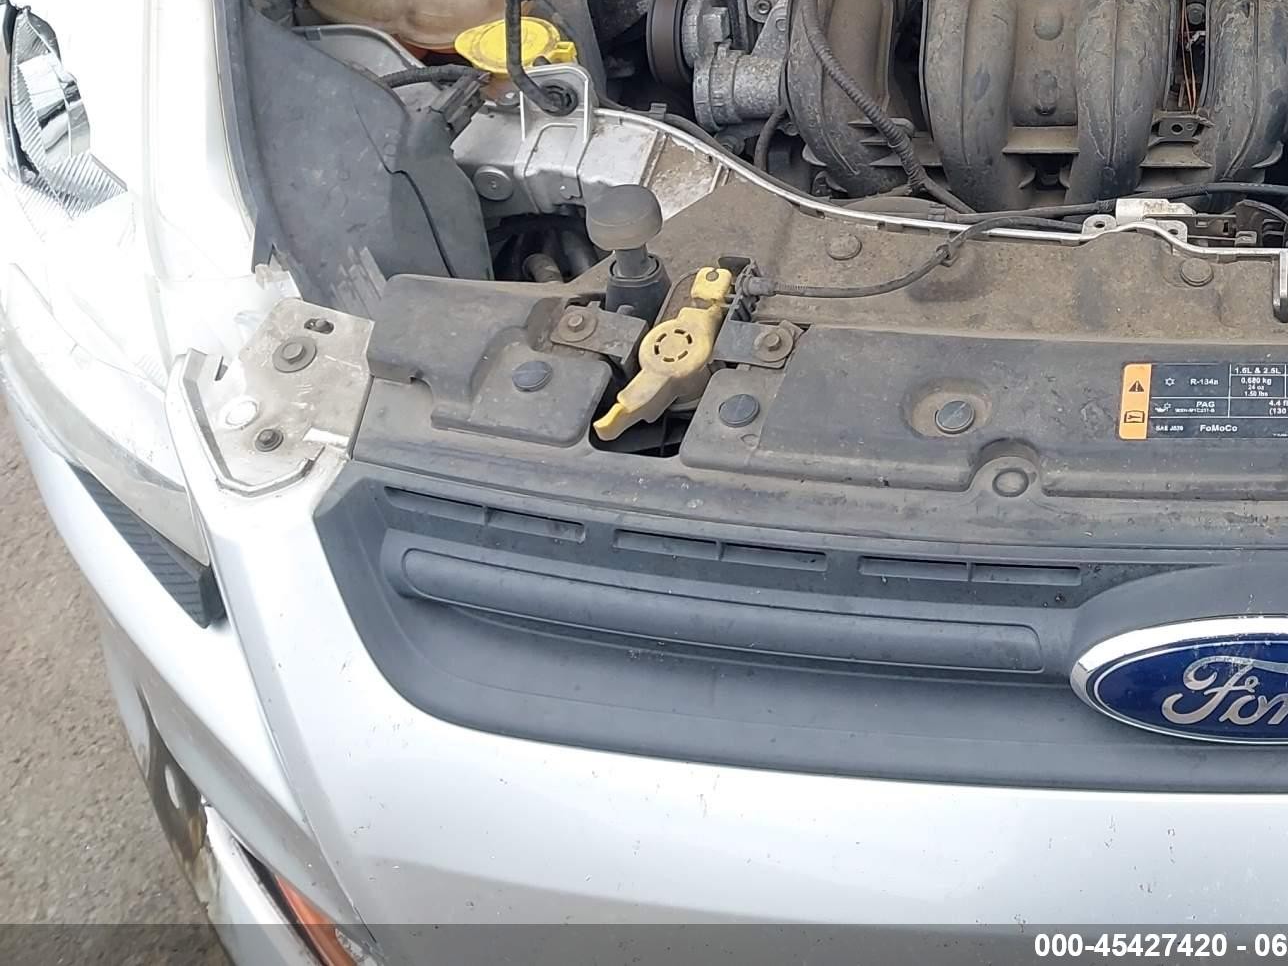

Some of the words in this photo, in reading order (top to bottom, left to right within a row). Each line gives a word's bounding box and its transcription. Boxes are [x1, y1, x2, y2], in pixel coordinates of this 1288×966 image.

[1234, 366, 1252, 374] 1.6L
[1254, 366, 1261, 374] &
[1190, 378, 1219, 386] R-134a
[1262, 377, 1272, 386] kg
[1199, 424, 1238, 432] FoMoCo
